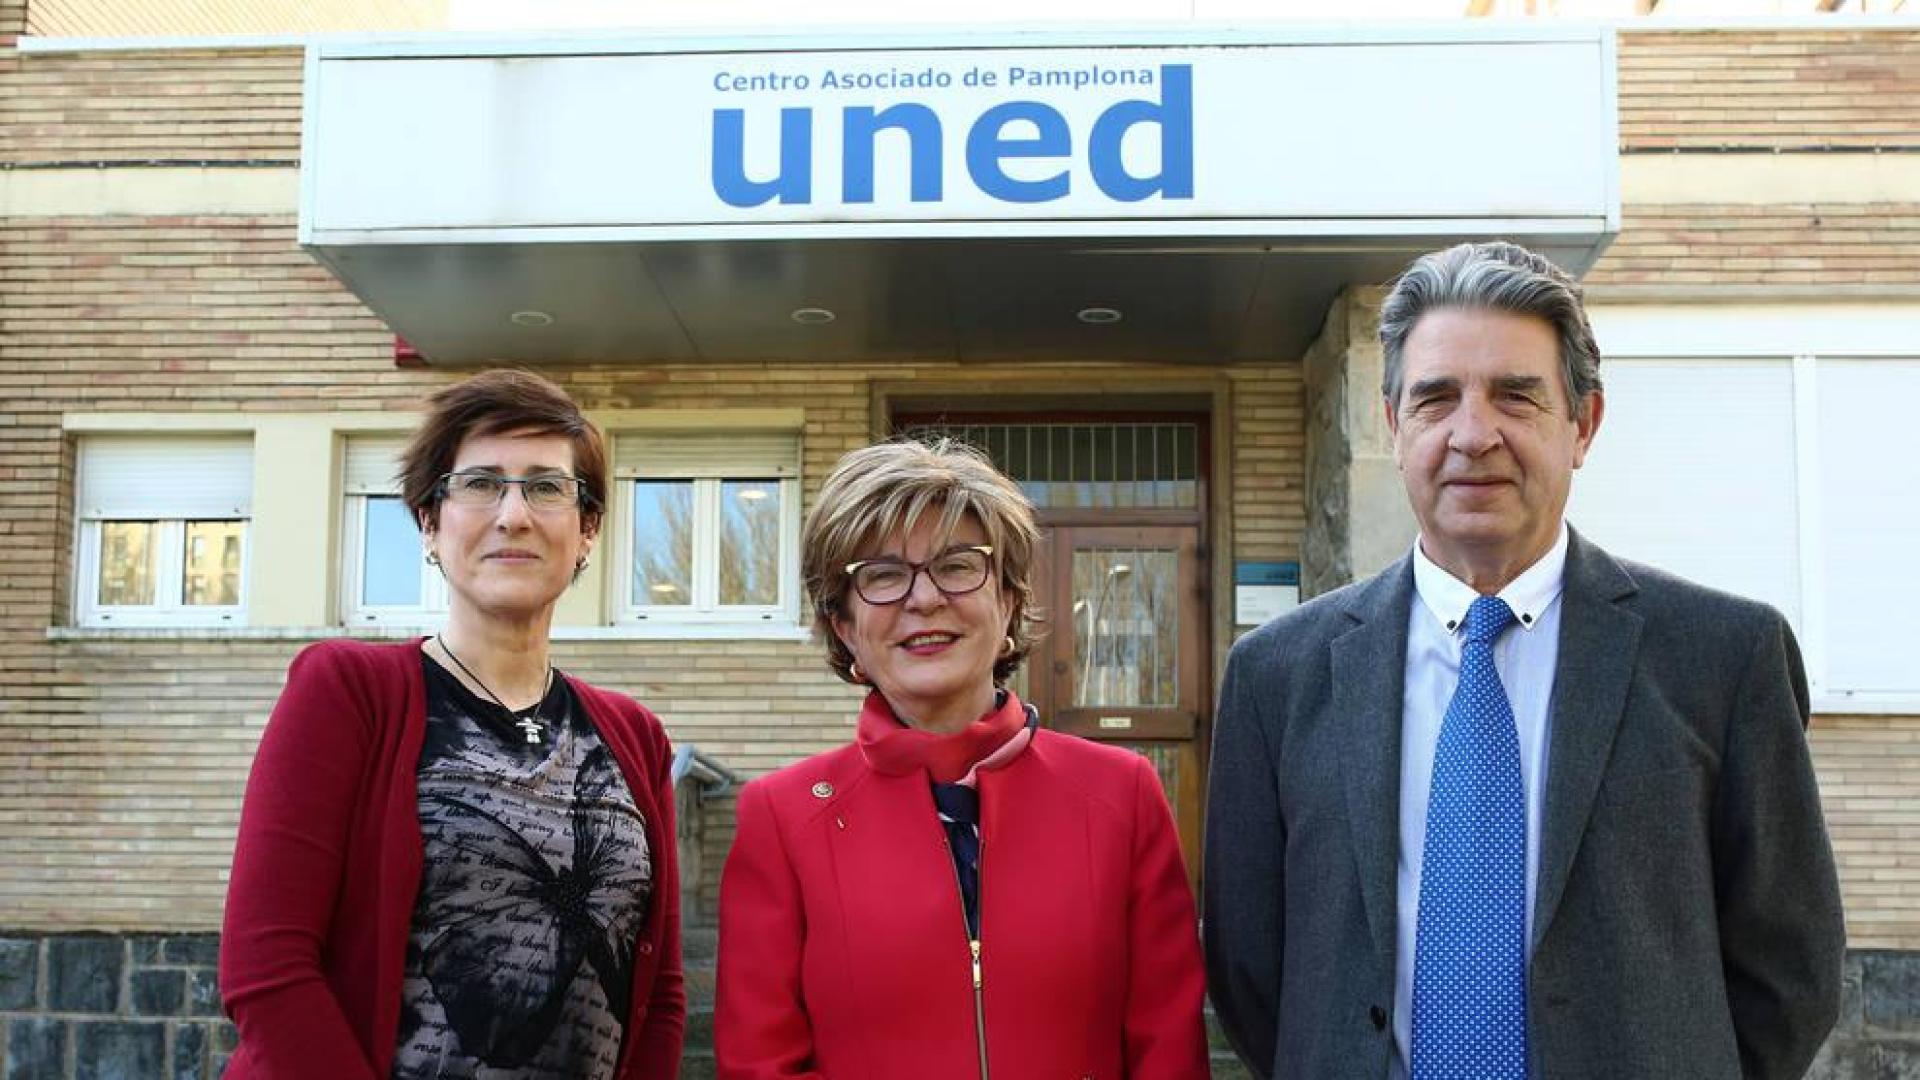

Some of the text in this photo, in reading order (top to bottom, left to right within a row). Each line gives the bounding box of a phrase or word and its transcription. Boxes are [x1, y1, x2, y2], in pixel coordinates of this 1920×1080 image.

[713, 64, 1153, 92] Centro Asociado de Pamplona
[711, 63, 1194, 207] uned
